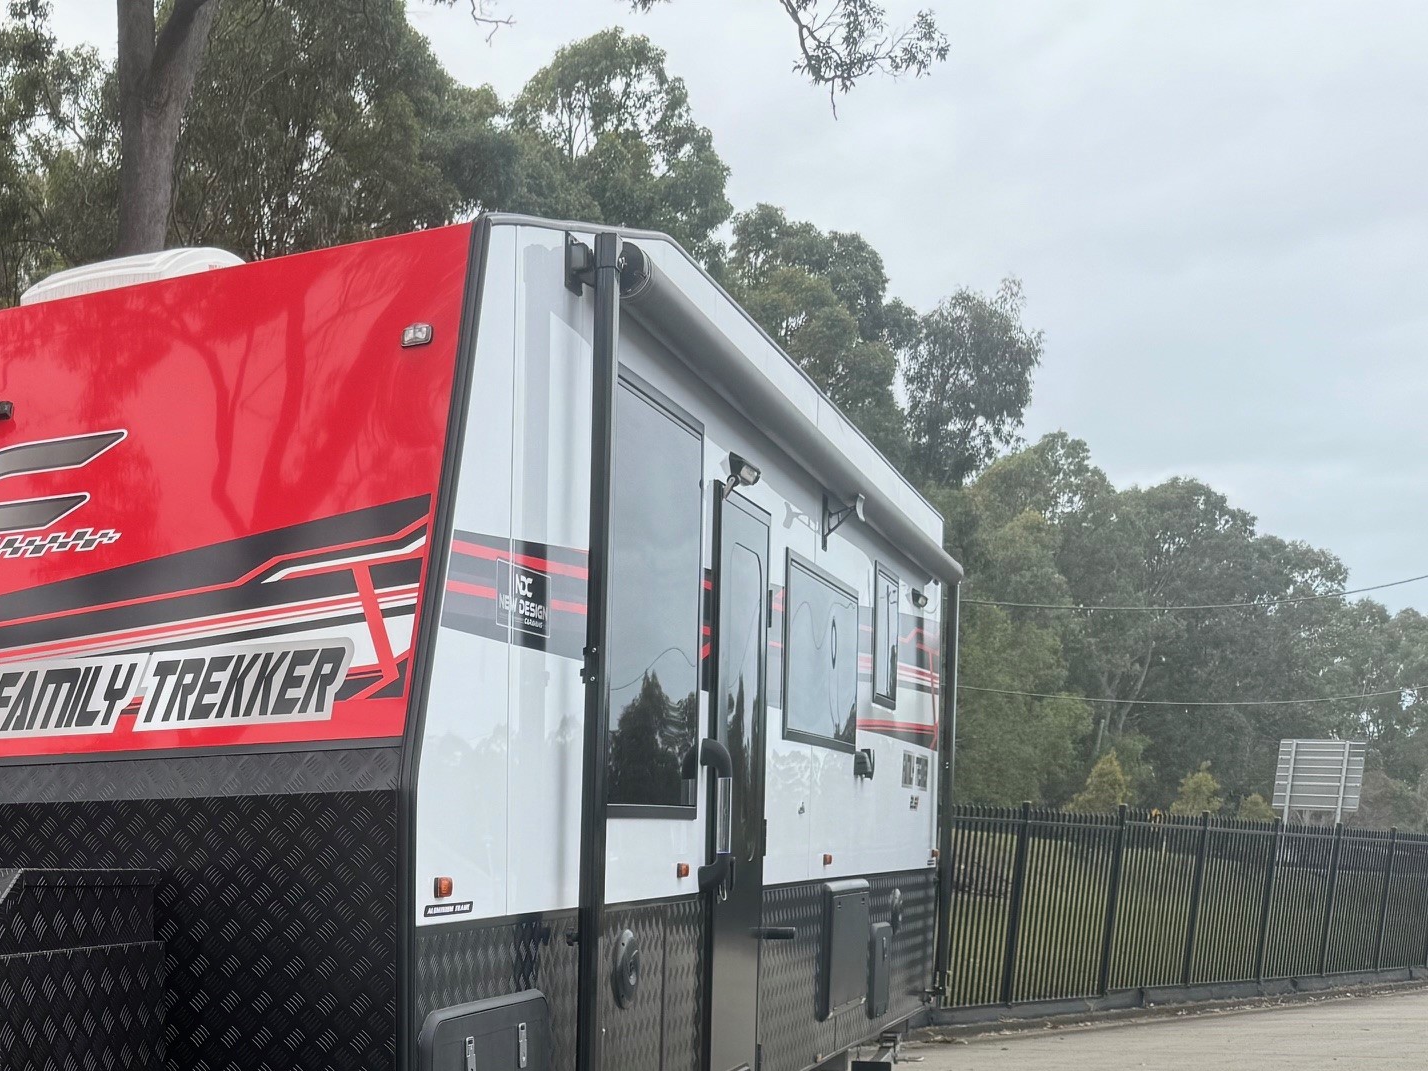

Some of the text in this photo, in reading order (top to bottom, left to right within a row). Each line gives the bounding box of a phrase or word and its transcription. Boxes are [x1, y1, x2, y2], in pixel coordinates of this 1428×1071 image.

[515, 573, 533, 598] NDC
[498, 592, 548, 621] NEW DESIGN
[142, 646, 346, 723] TREKKER
